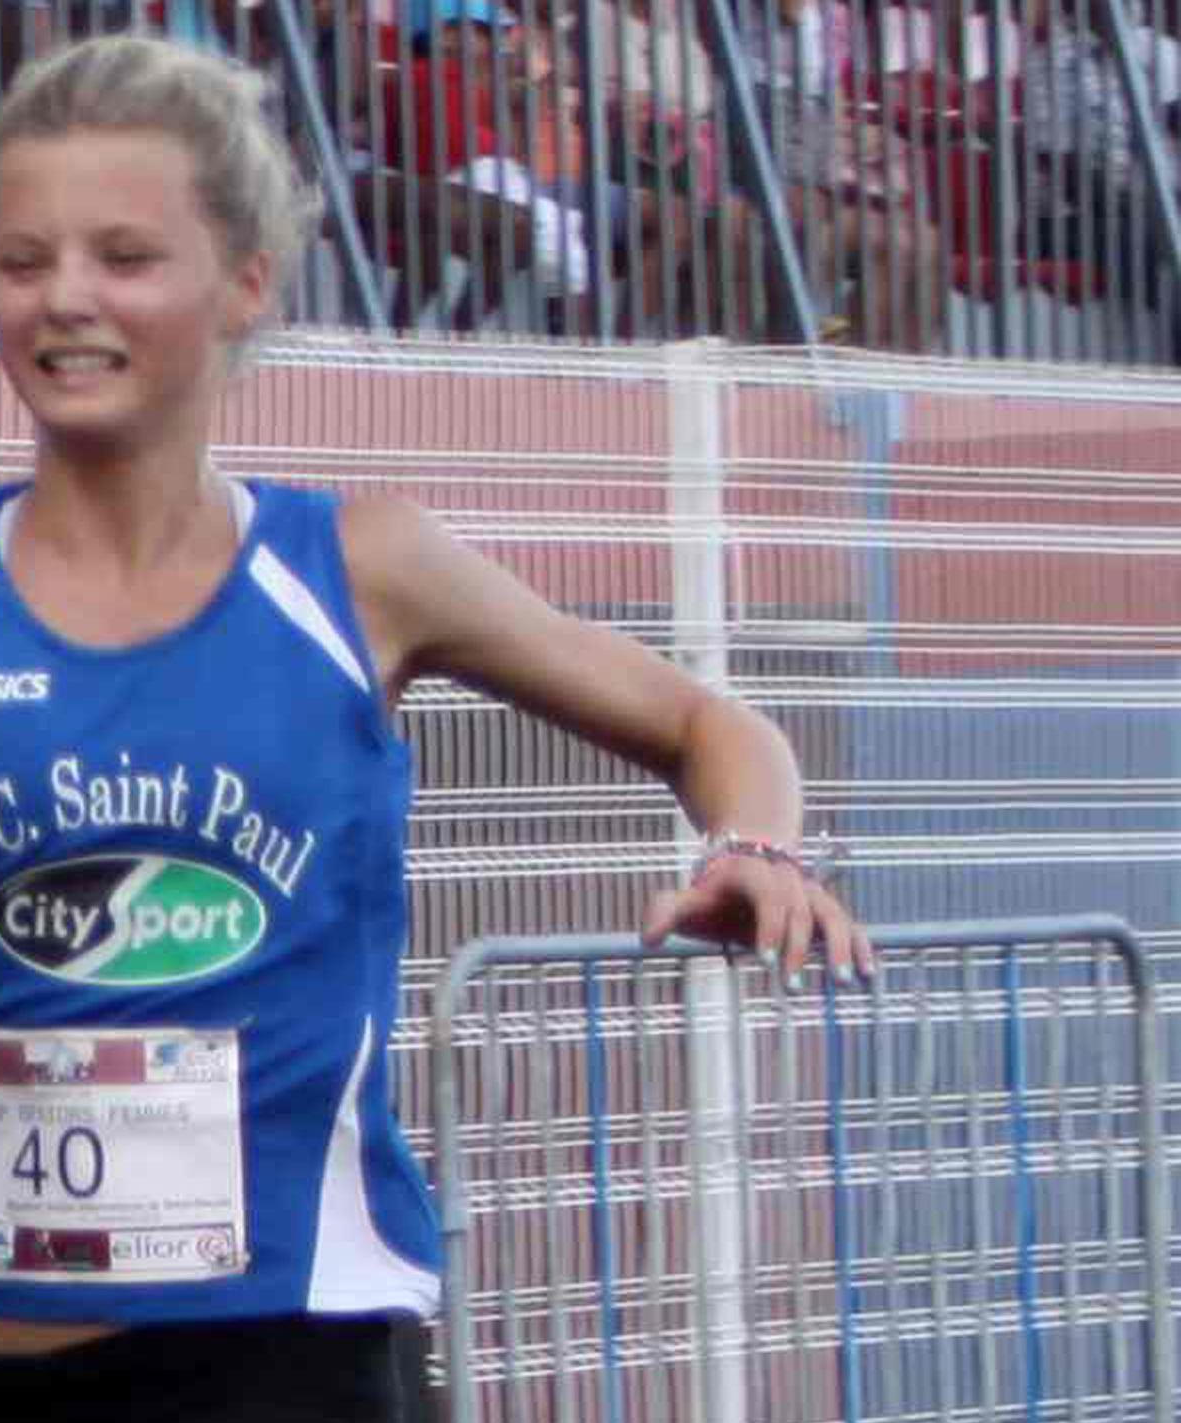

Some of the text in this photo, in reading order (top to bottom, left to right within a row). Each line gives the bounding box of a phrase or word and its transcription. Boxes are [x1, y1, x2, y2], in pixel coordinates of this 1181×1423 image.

[51, 751, 190, 830] Saint
[198, 766, 316, 899] Paul
[11, 1125, 105, 1198] 40
